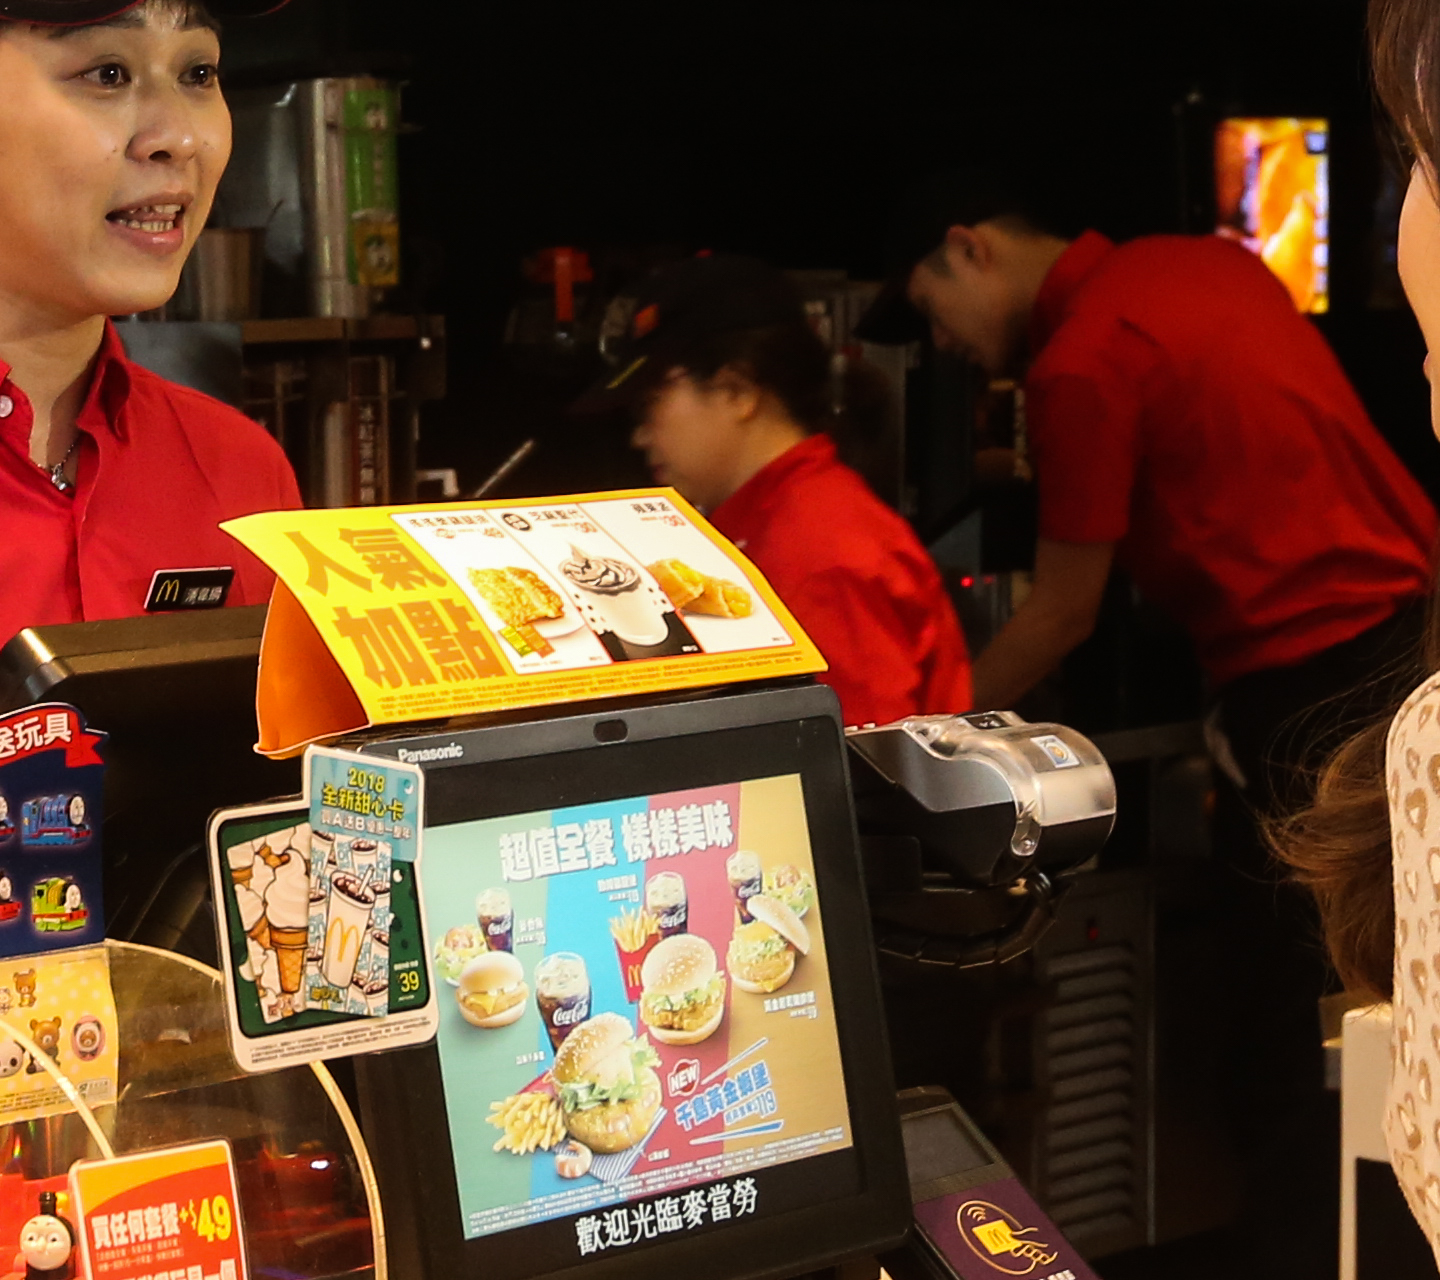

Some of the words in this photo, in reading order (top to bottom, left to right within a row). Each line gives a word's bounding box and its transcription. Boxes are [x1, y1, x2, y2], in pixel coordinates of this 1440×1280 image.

[285, 527, 449, 599] 人氣
[333, 596, 516, 692] 加點
[347, 766, 386, 793] 2018
[397, 741, 464, 766] Panasonic
[321, 782, 405, 822] 全新甜心卡
[500, 818, 616, 883] 超值全餐
[622, 799, 735, 863] 樣樣美味
[669, 1065, 699, 1093] NEW
[91, 1202, 180, 1250] 買任何套餐
[180, 1195, 232, 1243] +$49
[575, 1177, 760, 1257] 歡迎光臨麥當勞
